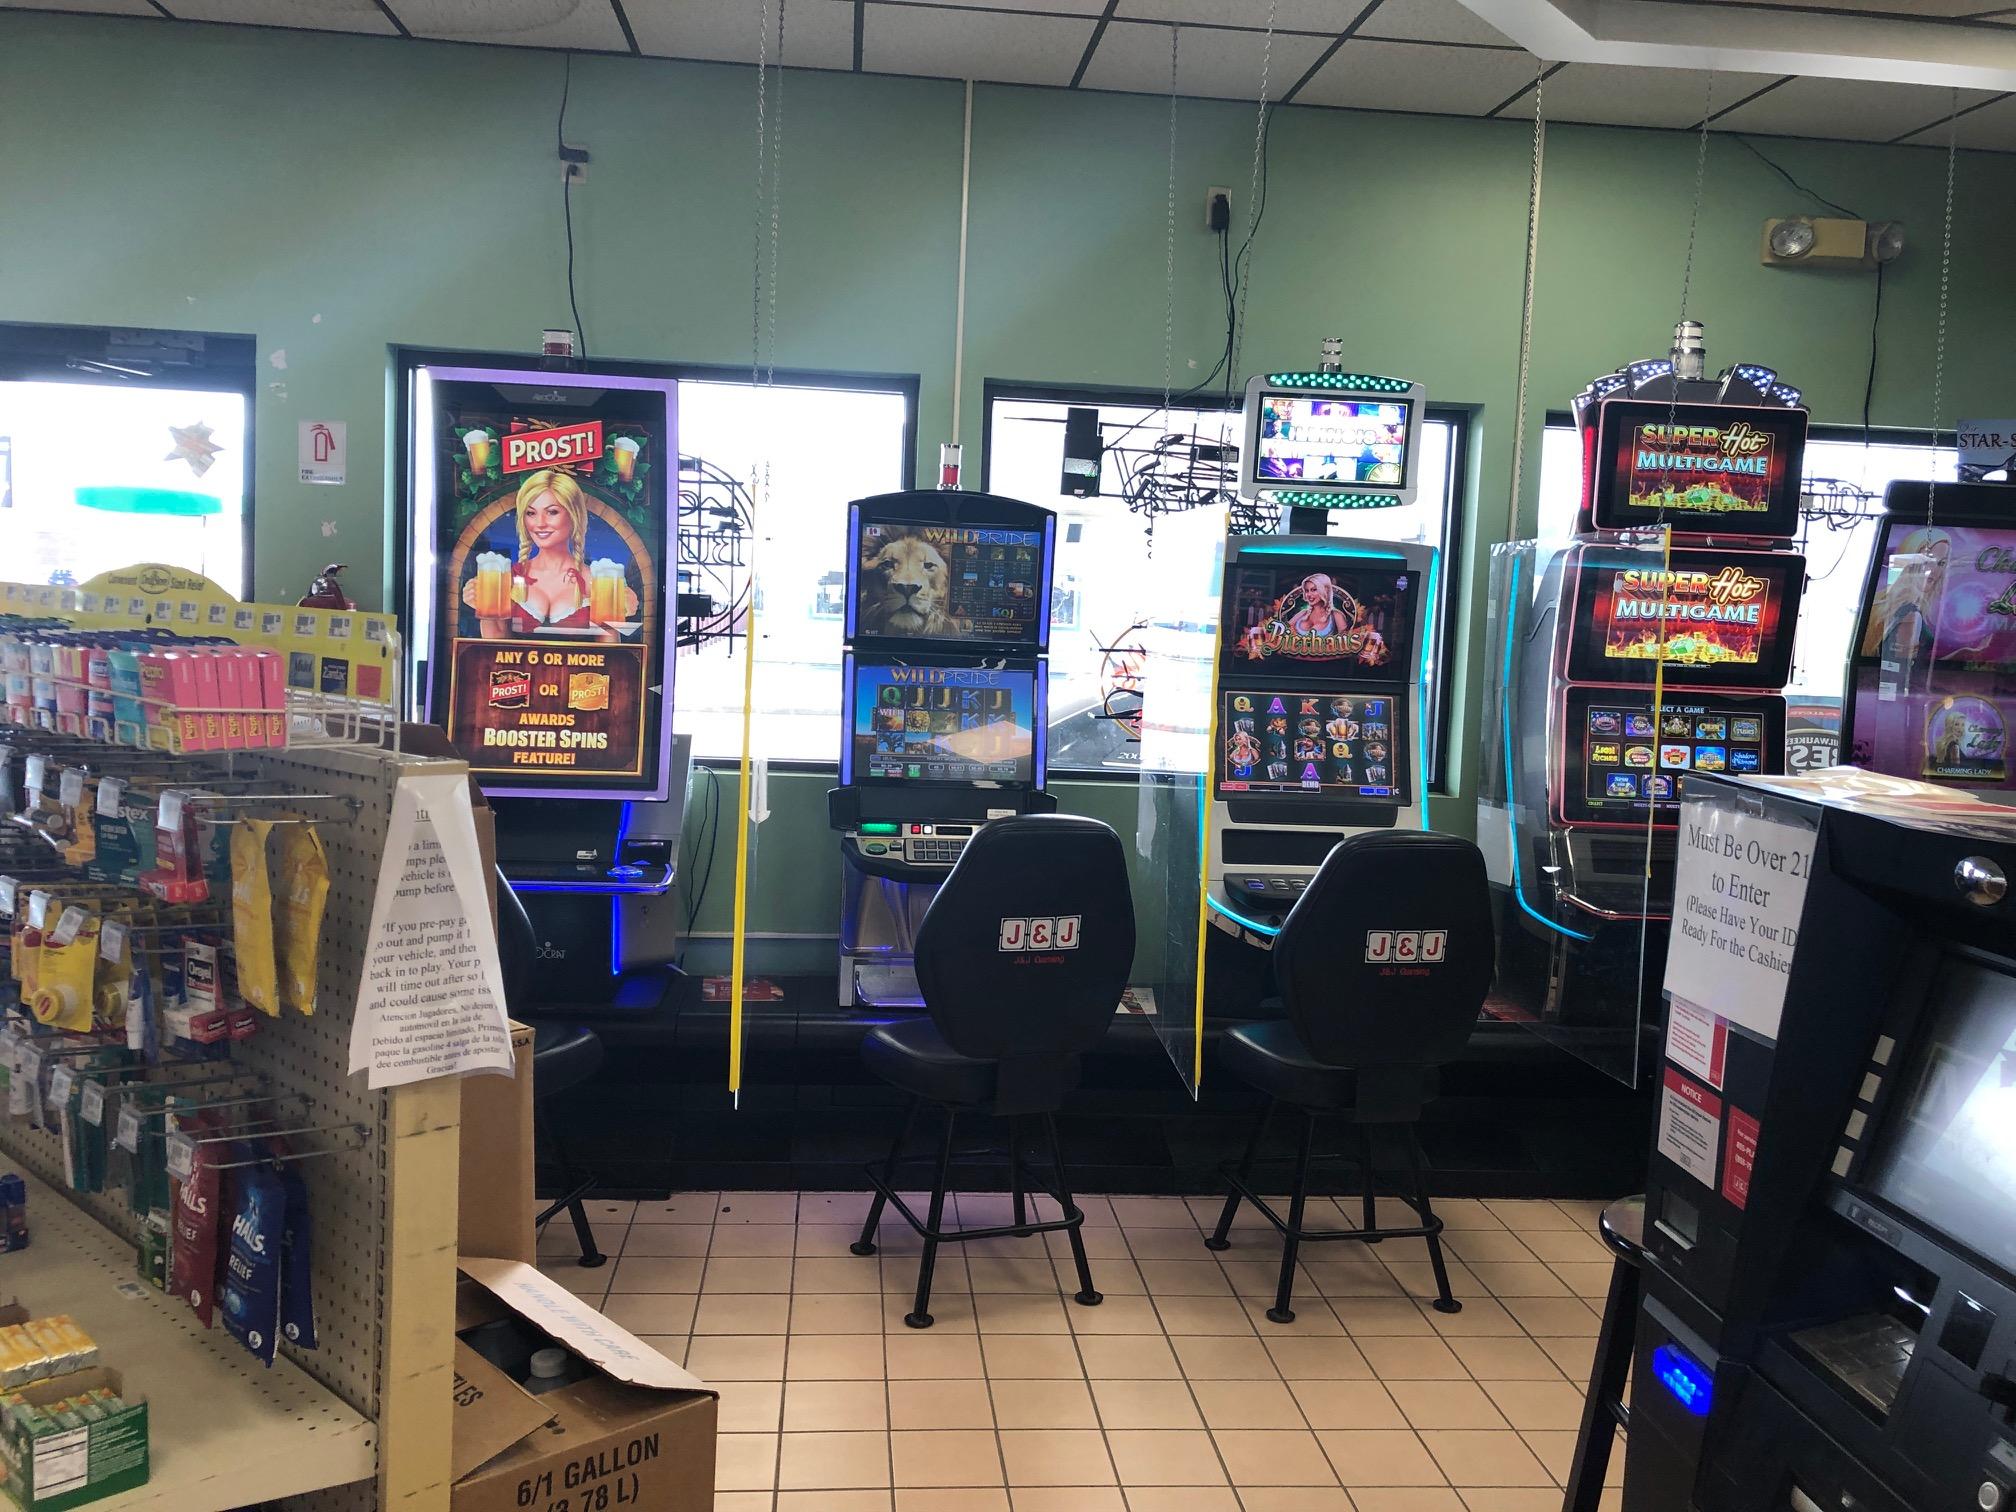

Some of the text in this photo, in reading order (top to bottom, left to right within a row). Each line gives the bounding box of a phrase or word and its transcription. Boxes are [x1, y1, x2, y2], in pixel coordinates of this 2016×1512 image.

[509, 431, 594, 467] PROST!
[1642, 423, 1768, 457] SUPER Hot
[1637, 451, 1767, 474] MULTIGAME
[924, 527, 1035, 546] WILD PRIDE
[1623, 567, 1763, 605] SUPER Hot
[1616, 599, 1761, 624] MULTIGAME
[1263, 620, 1364, 656] Bierhaus
[495, 650, 605, 666] ANY 6 OR MORE
[891, 668, 999, 685] WILD PRIDE
[491, 684, 527, 699] PROST!
[539, 684, 559, 696] OR
[571, 687, 606, 700] PROST!
[519, 713, 575, 726] AWARDS
[484, 728, 608, 749] BOOSTER SPINS
[513, 752, 576, 765] FEATURE!
[1688, 824, 1809, 880] Must Be Over 21
[424, 883, 455, 895] before
[1712, 873, 1771, 908] to Enter
[398, 921, 417, 934] you
[419, 917, 456, 932] pre-pay
[1686, 895, 1798, 948] (Please Have Your ID
[386, 938, 404, 949] out
[406, 935, 424, 947] and
[426, 932, 454, 947] pump
[1682, 918, 1709, 944] Ready
[1710, 931, 1728, 951] For
[1729, 938, 1746, 959] the
[372, 953, 394, 968] your
[439, 948, 456, 957] and
[395, 966, 406, 977] in
[408, 967, 418, 976] to
[448, 958, 471, 970] Your
[376, 973, 478, 994] will time out after so
[369, 998, 387, 1010] and
[389, 995, 419, 1008] could
[421, 992, 448, 1004] cause
[372, 1034, 404, 1047] Debido
[1681, 1083, 1703, 1104] NOTICE
[229, 1254, 253, 1280] RELIEF
[518, 1432, 660, 1507] 6/1 GALLON
[617, 1472, 639, 1504] L)
